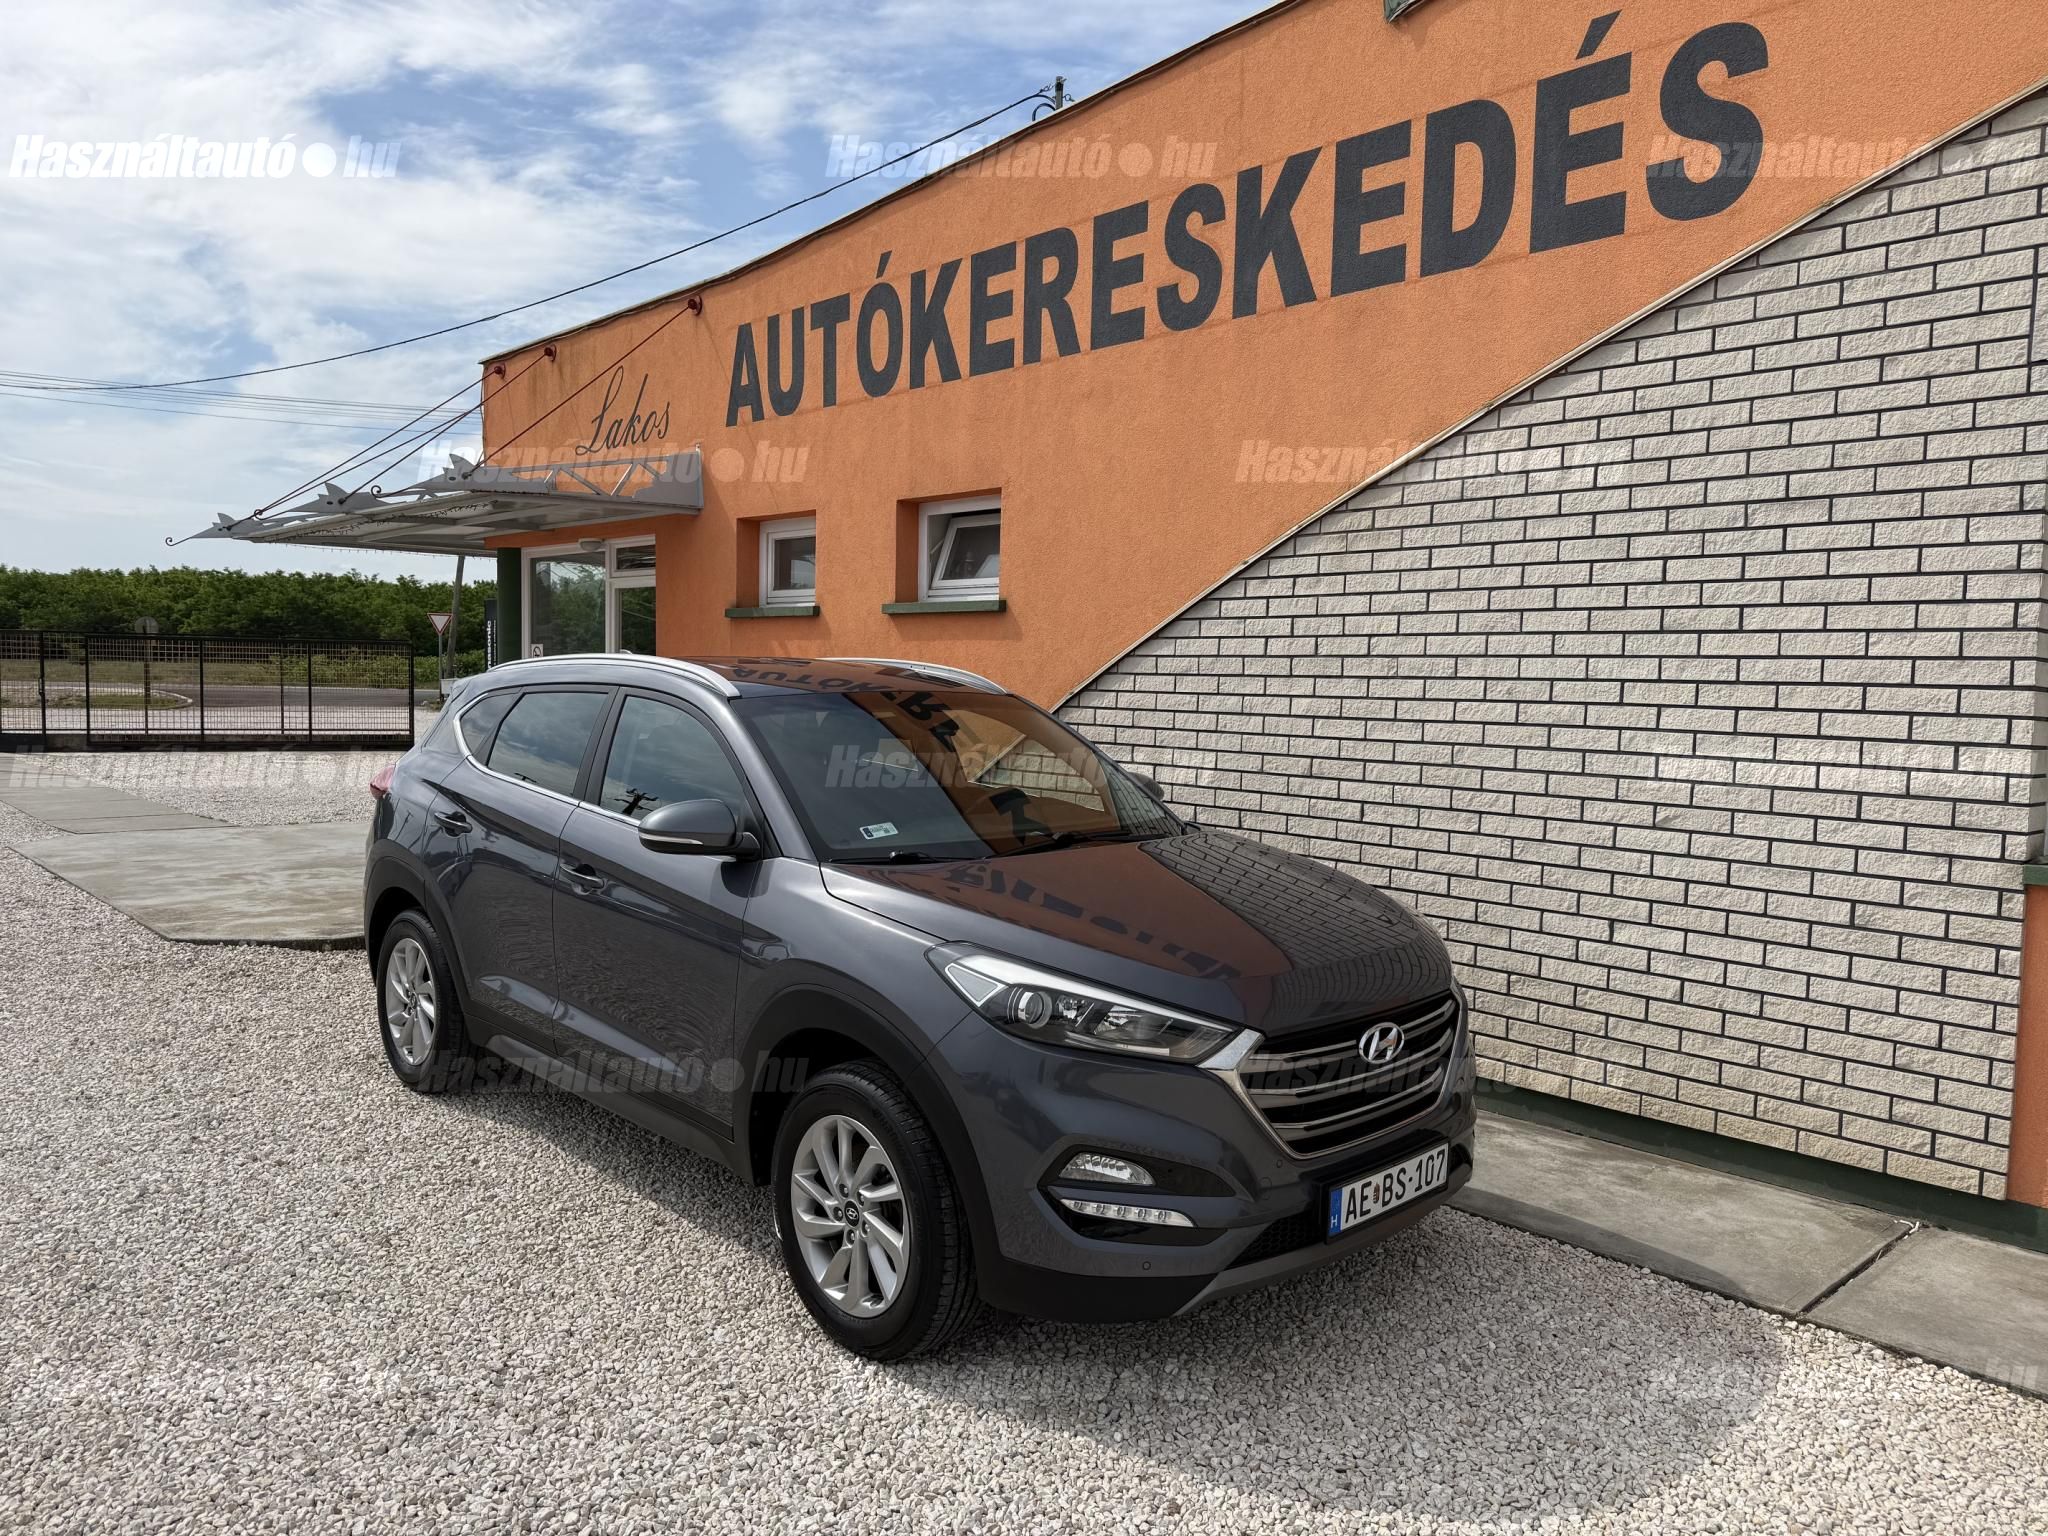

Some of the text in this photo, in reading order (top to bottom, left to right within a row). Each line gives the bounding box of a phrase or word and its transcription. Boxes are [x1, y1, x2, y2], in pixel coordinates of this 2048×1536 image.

[725, 9, 1769, 427] AUTÓKERESKEDÉS
[575, 365, 670, 456] Lakos
[1345, 1180, 1372, 1224] AE
